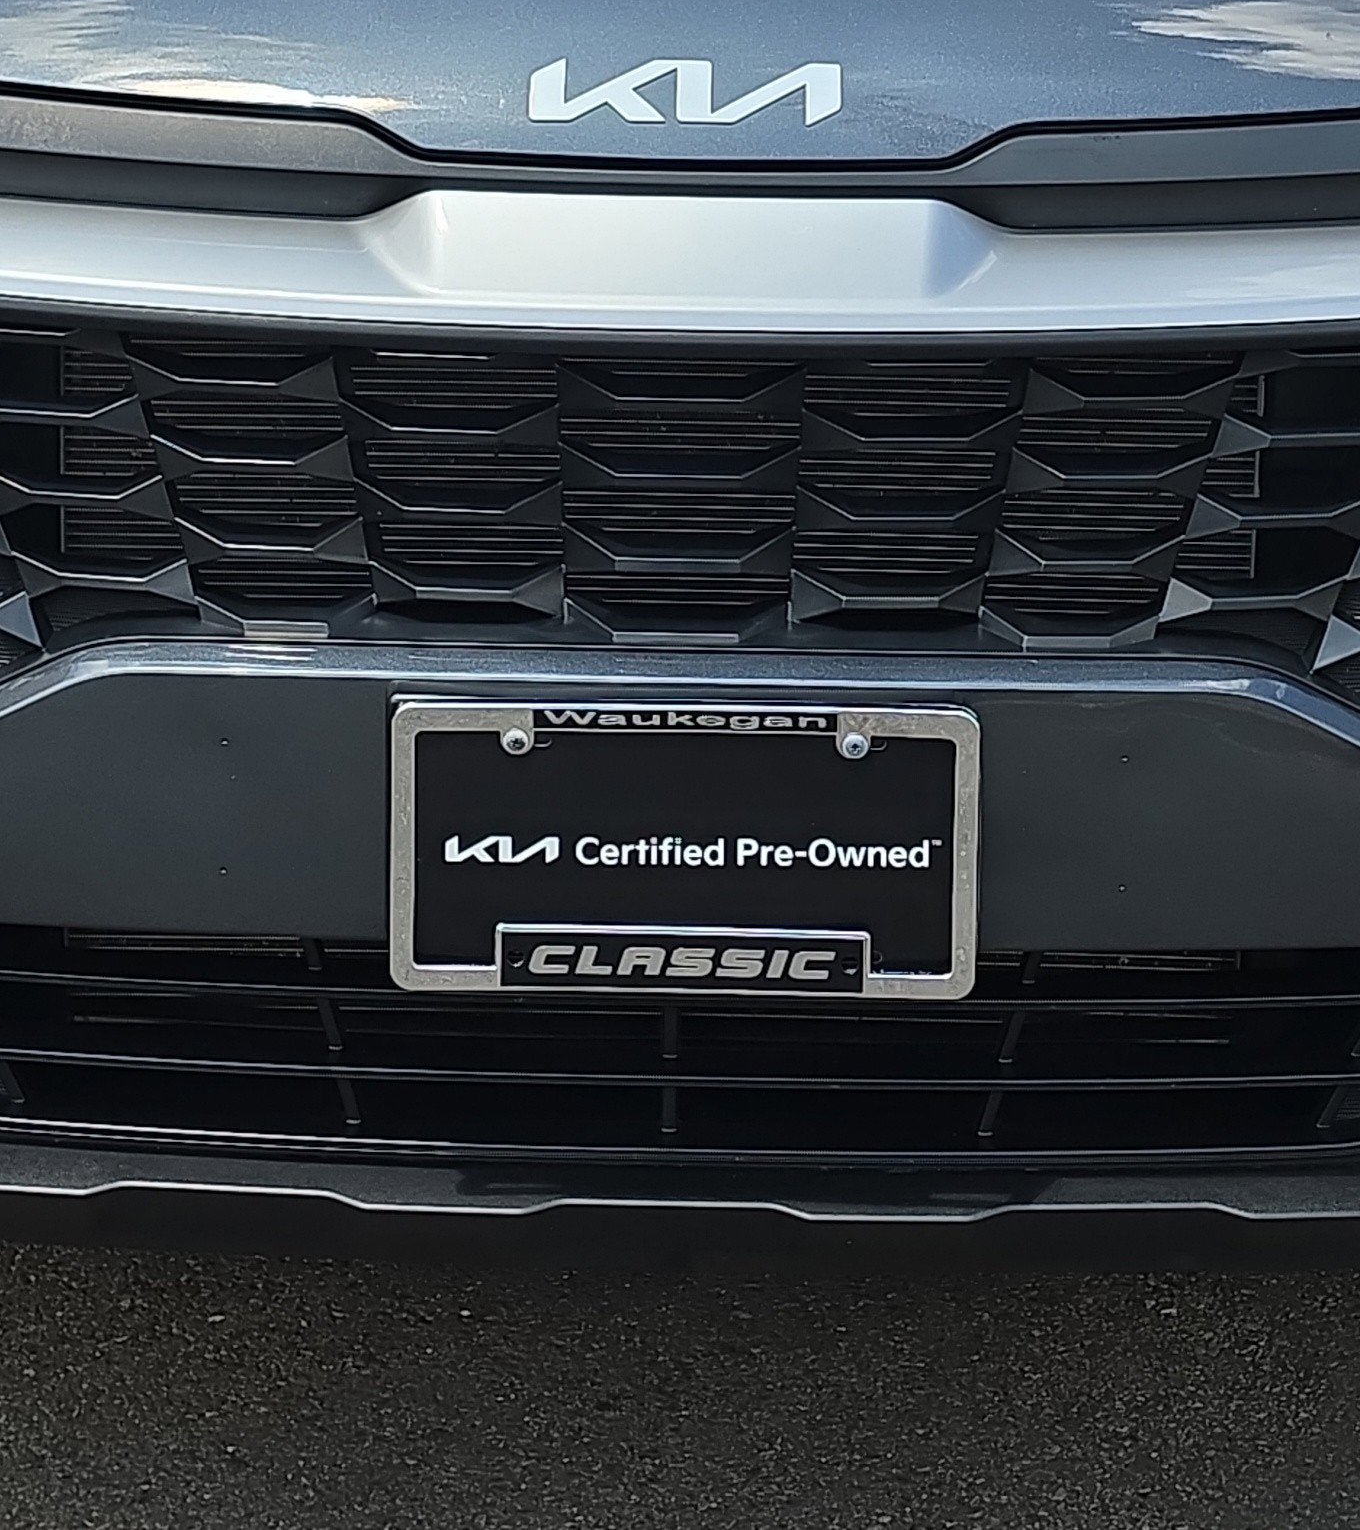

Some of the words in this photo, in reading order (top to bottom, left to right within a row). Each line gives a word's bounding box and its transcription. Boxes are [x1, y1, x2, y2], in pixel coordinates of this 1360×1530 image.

[543, 710, 828, 730] Waukegan
[575, 836, 725, 866] Certified
[528, 945, 837, 980] CLASSIC
